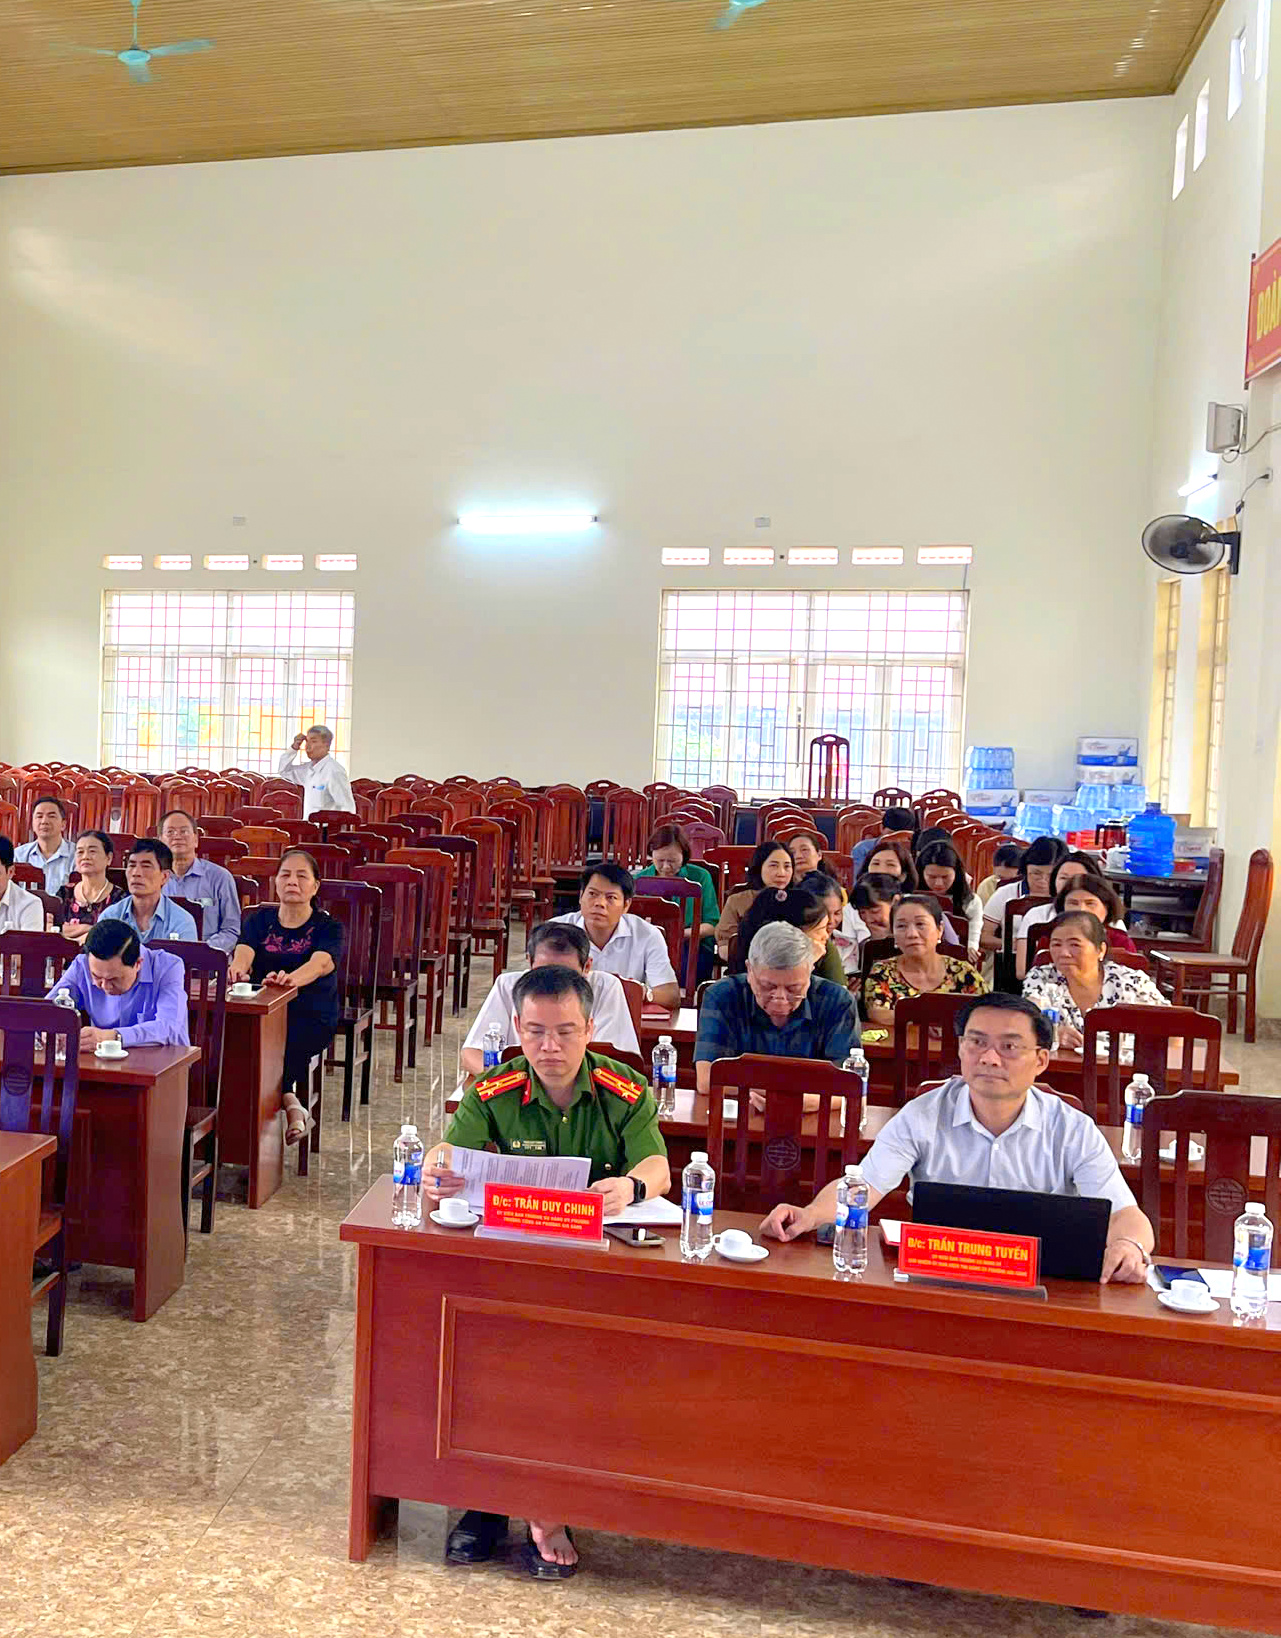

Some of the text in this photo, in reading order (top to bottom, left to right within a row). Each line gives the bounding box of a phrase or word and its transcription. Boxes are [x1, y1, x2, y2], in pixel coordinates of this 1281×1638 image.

[492, 1195, 512, 1208] Đ/c:
[542, 1199, 562, 1214] DUY
[957, 1241, 992, 1257] TRUNG
[995, 1245, 1029, 1261] TUYẾN
